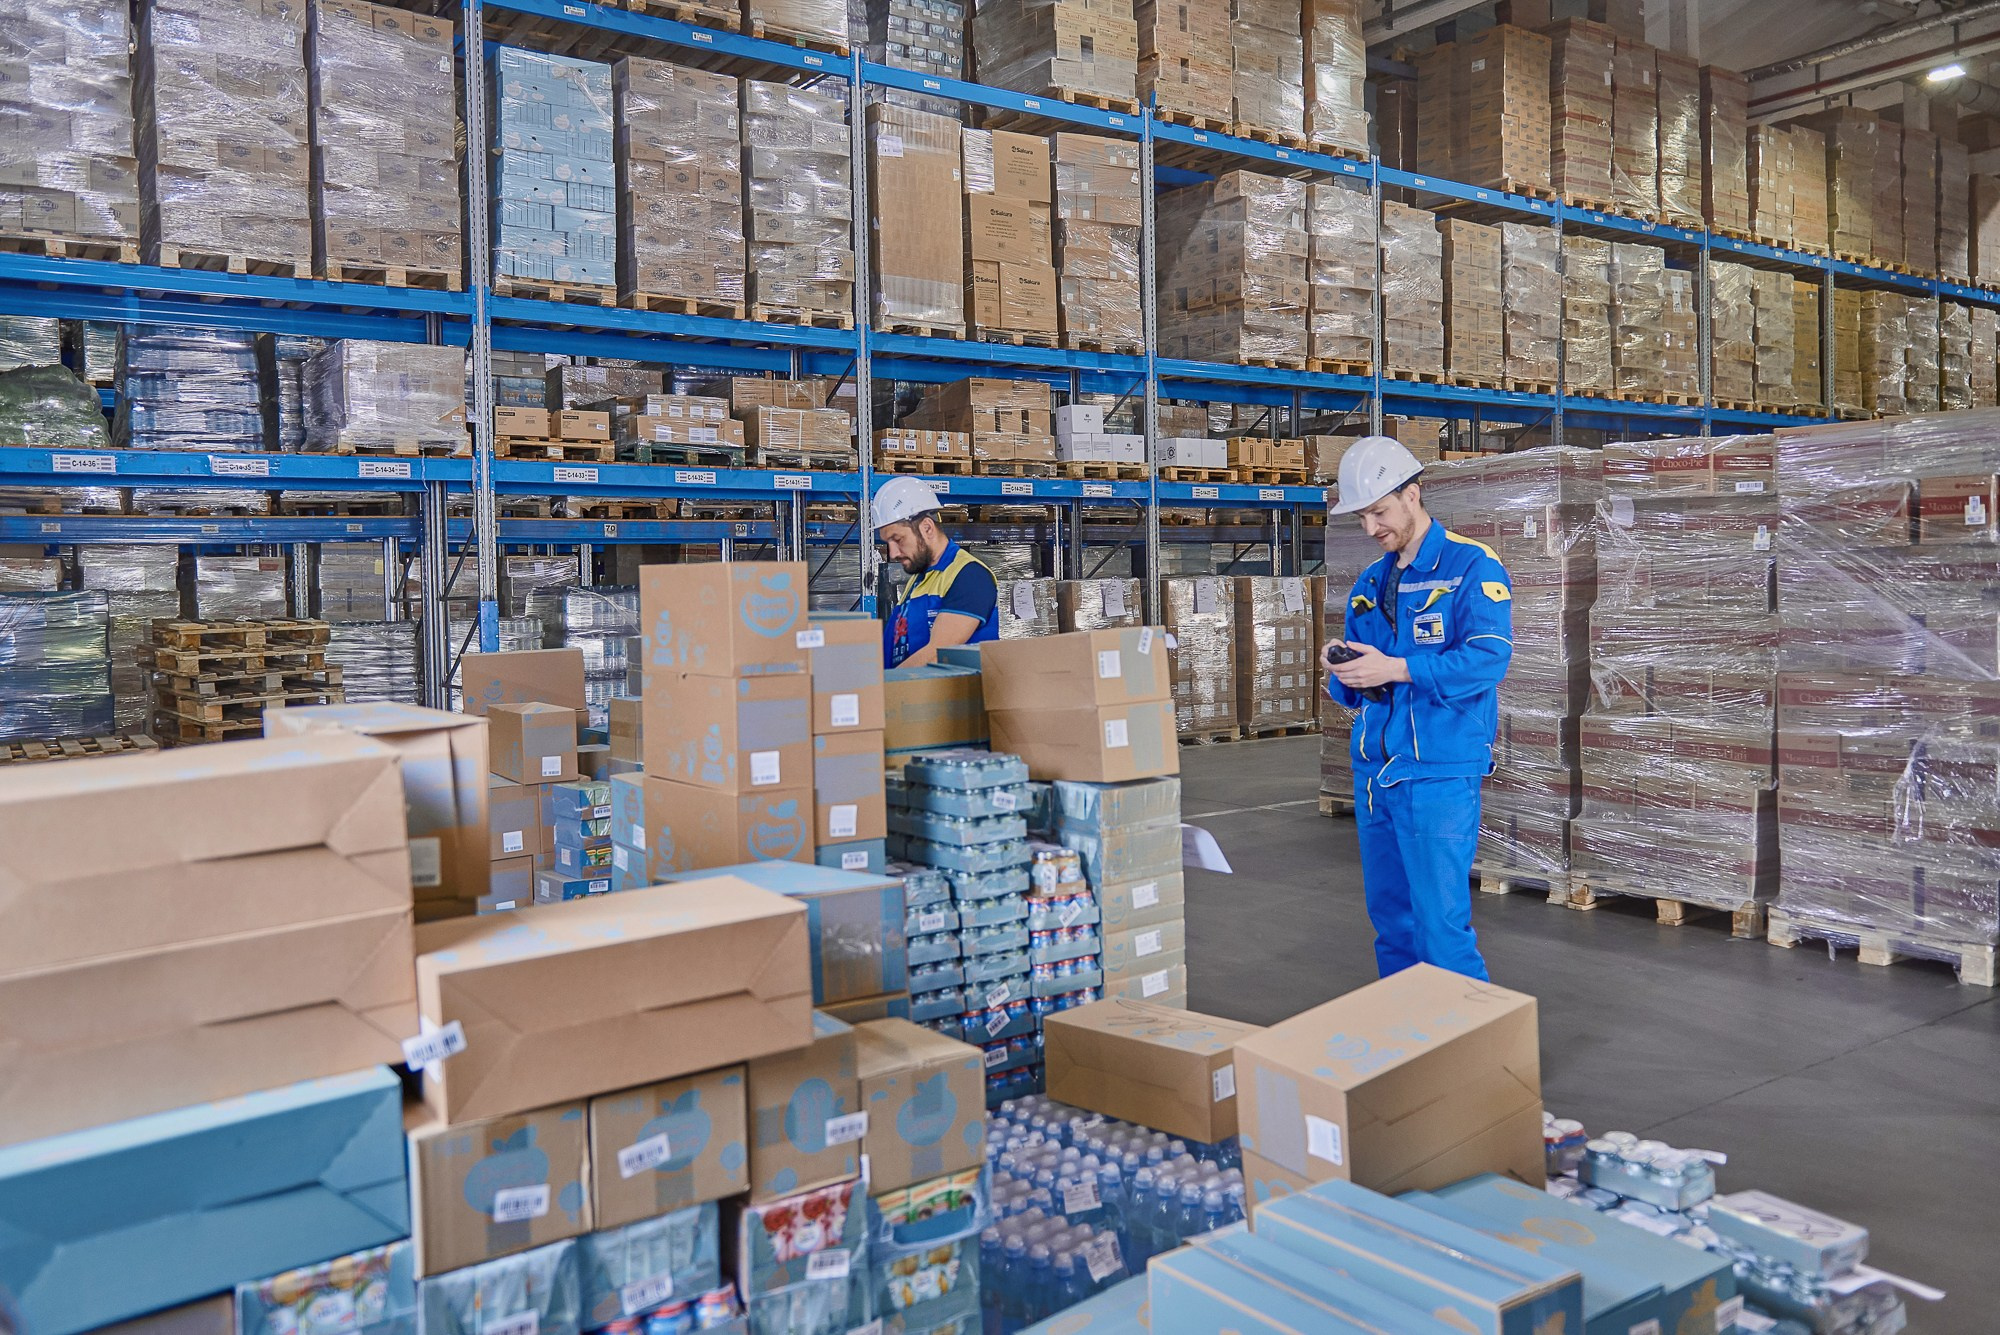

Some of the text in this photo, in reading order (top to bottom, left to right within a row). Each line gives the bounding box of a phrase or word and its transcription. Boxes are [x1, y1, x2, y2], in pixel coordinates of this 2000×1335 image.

[1016, 147, 1034, 156] Sakura
[995, 210, 1013, 218] Sakura
[980, 276, 998, 284] Sakura
[1023, 278, 1041, 286] Sakura
[71, 459, 97, 468] C-14-36
[1661, 459, 1703, 468] Choco-Pie
[374, 466, 396, 474] C-14-34
